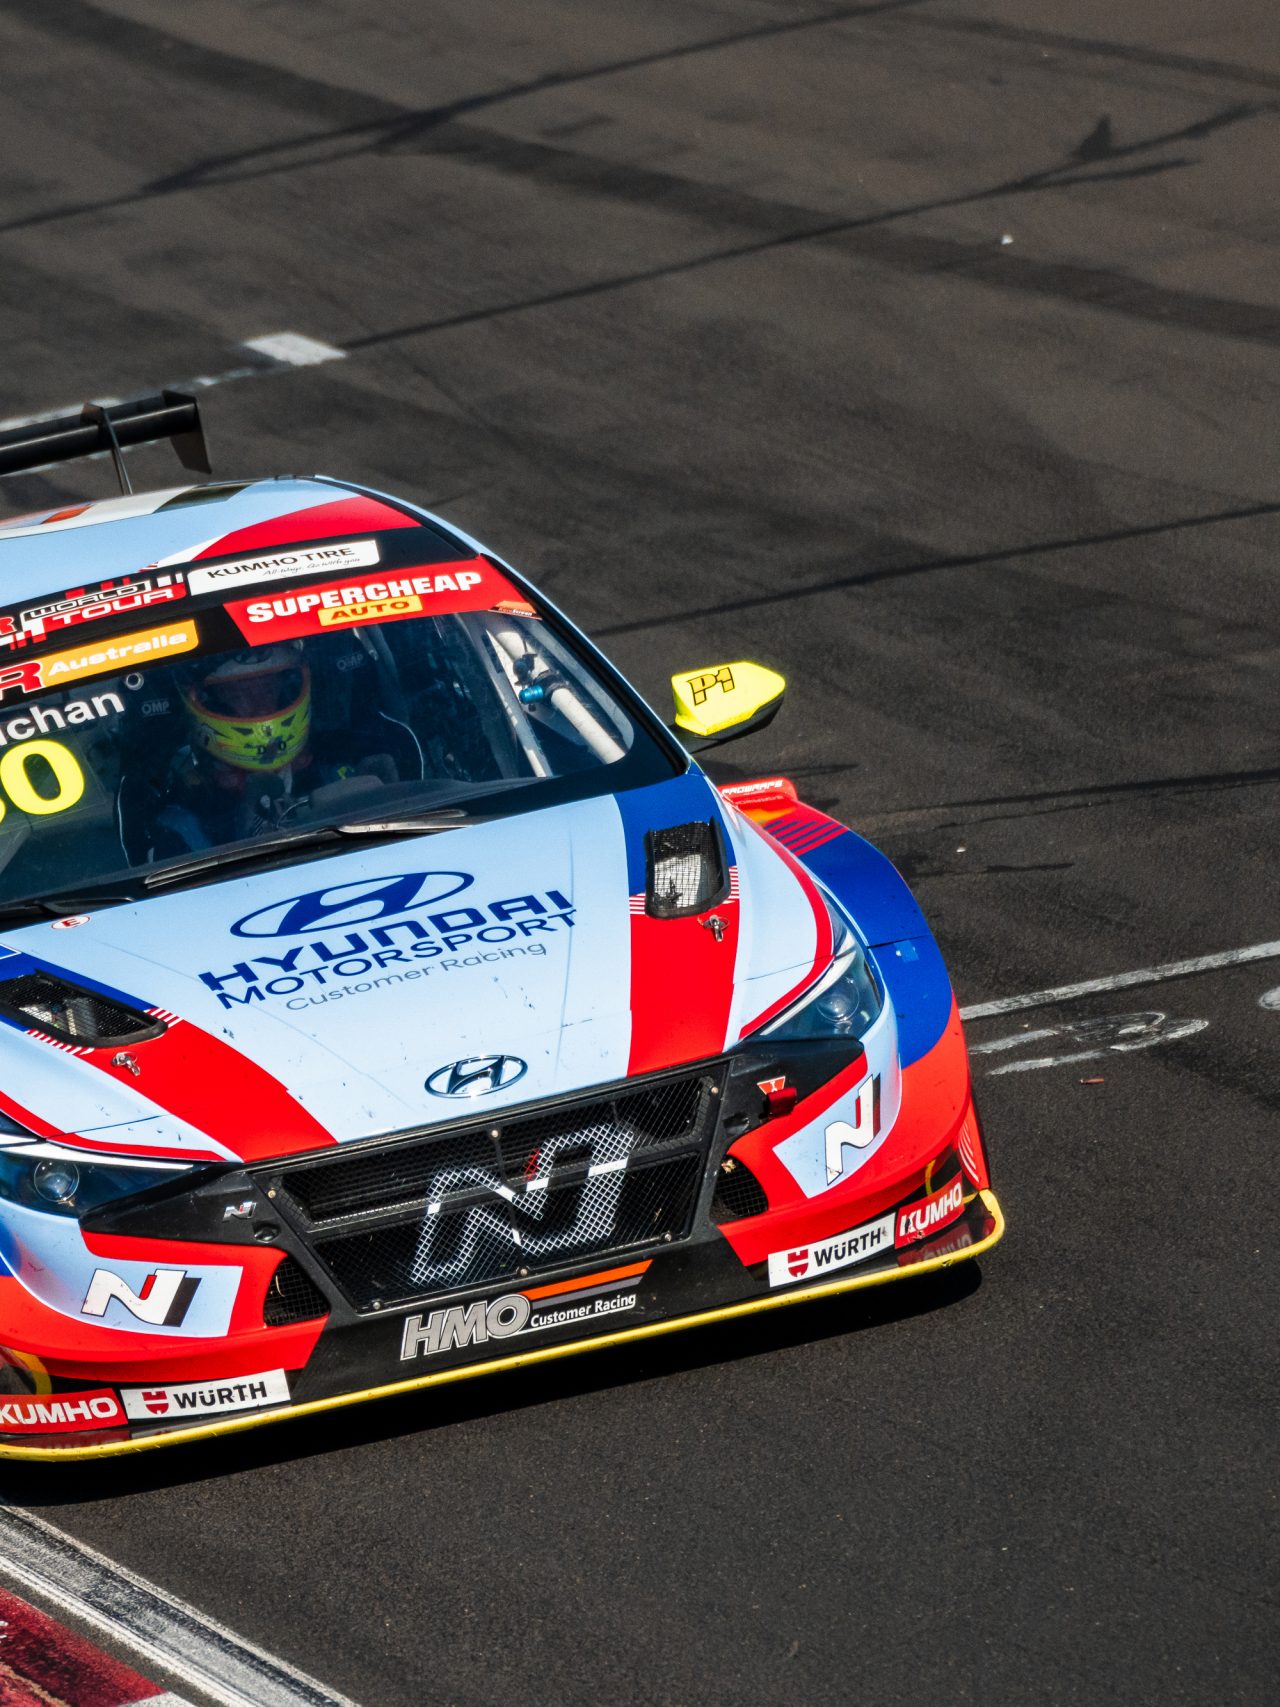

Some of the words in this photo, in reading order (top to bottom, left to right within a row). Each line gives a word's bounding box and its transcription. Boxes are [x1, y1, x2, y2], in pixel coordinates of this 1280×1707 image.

[207, 556, 297, 578] KUMHO
[300, 548, 355, 561] TIRE
[29, 584, 138, 617] WORLD
[51, 588, 175, 625] TOUR
[246, 571, 482, 623] SUPERCHEAP
[330, 599, 410, 621] AUTO
[48, 631, 188, 676] Australia
[687, 666, 736, 706] P1
[198, 890, 573, 991] HYUNDAI
[216, 909, 577, 1010] MOTORSPORT
[285, 966, 434, 1011] Customer
[441, 943, 547, 971] Racing
[900, 1183, 962, 1236] KUMHO
[814, 1227, 882, 1267] WÜRTH
[400, 1294, 531, 1361] HMO
[531, 1303, 592, 1328] Customer
[595, 1294, 637, 1312] Racing
[173, 1381, 268, 1409] WÜRTH
